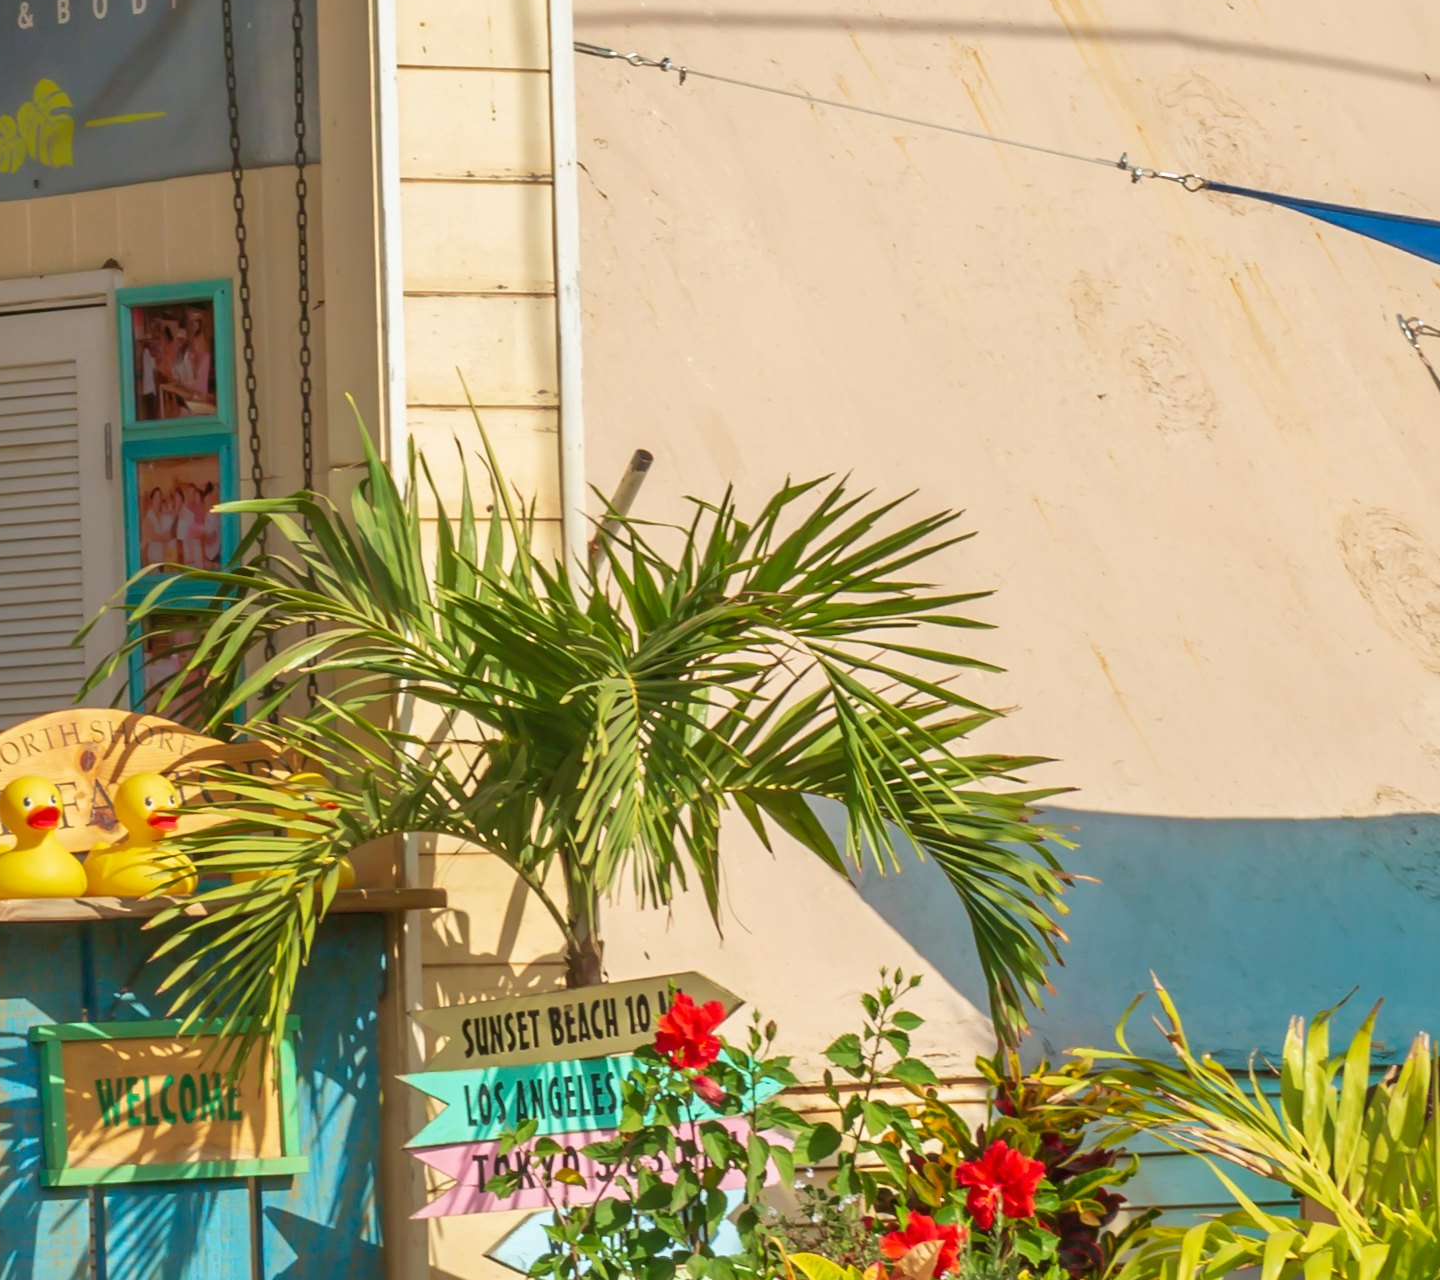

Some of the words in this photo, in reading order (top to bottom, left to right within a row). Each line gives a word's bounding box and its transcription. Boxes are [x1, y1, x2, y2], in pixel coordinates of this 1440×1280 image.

[90, 720, 195, 756] SHORE
[462, 1009, 541, 1059] SUNSET
[548, 997, 620, 1047] BEACH
[624, 993, 651, 1035] 10
[95, 1072, 242, 1128] WELCOME
[464, 1082, 507, 1127] LOS
[516, 1071, 617, 1121] ANGELES
